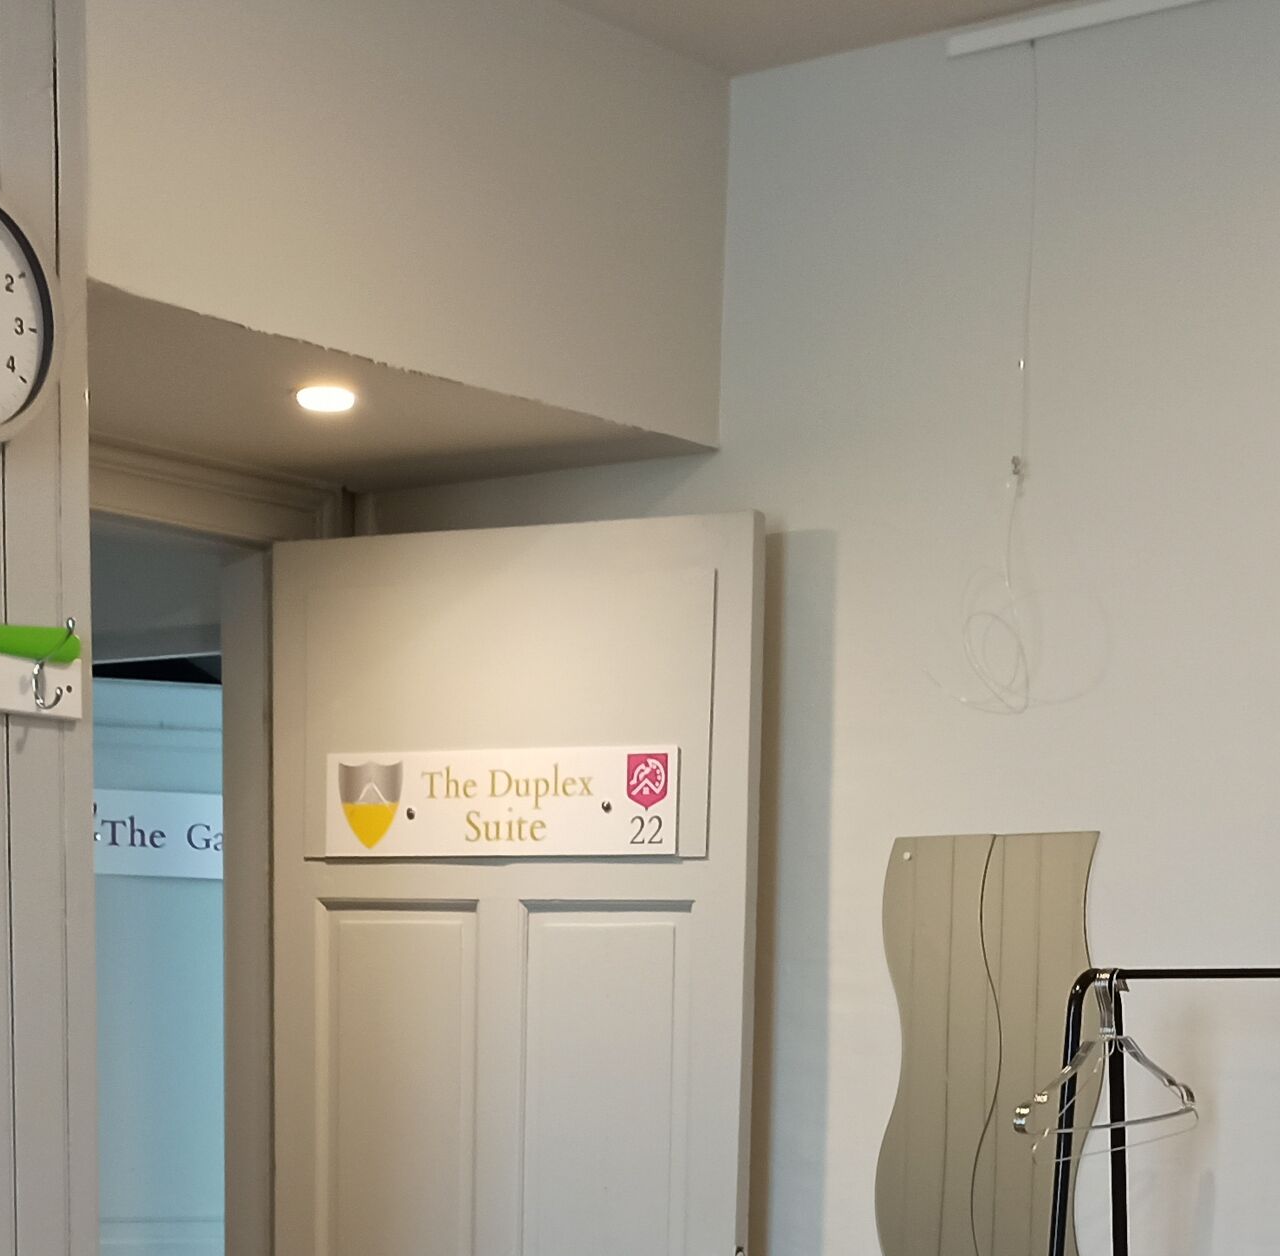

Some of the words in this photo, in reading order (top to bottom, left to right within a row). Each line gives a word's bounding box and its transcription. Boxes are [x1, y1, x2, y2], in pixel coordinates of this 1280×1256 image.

[4, 274, 15, 293] 2
[14, 317, 24, 336] 3
[6, 355, 16, 373] 4
[421, 766, 477, 799] The
[488, 763, 593, 810] Duplex
[101, 815, 166, 848] The
[465, 807, 546, 842] Suite
[630, 815, 663, 845] 22
